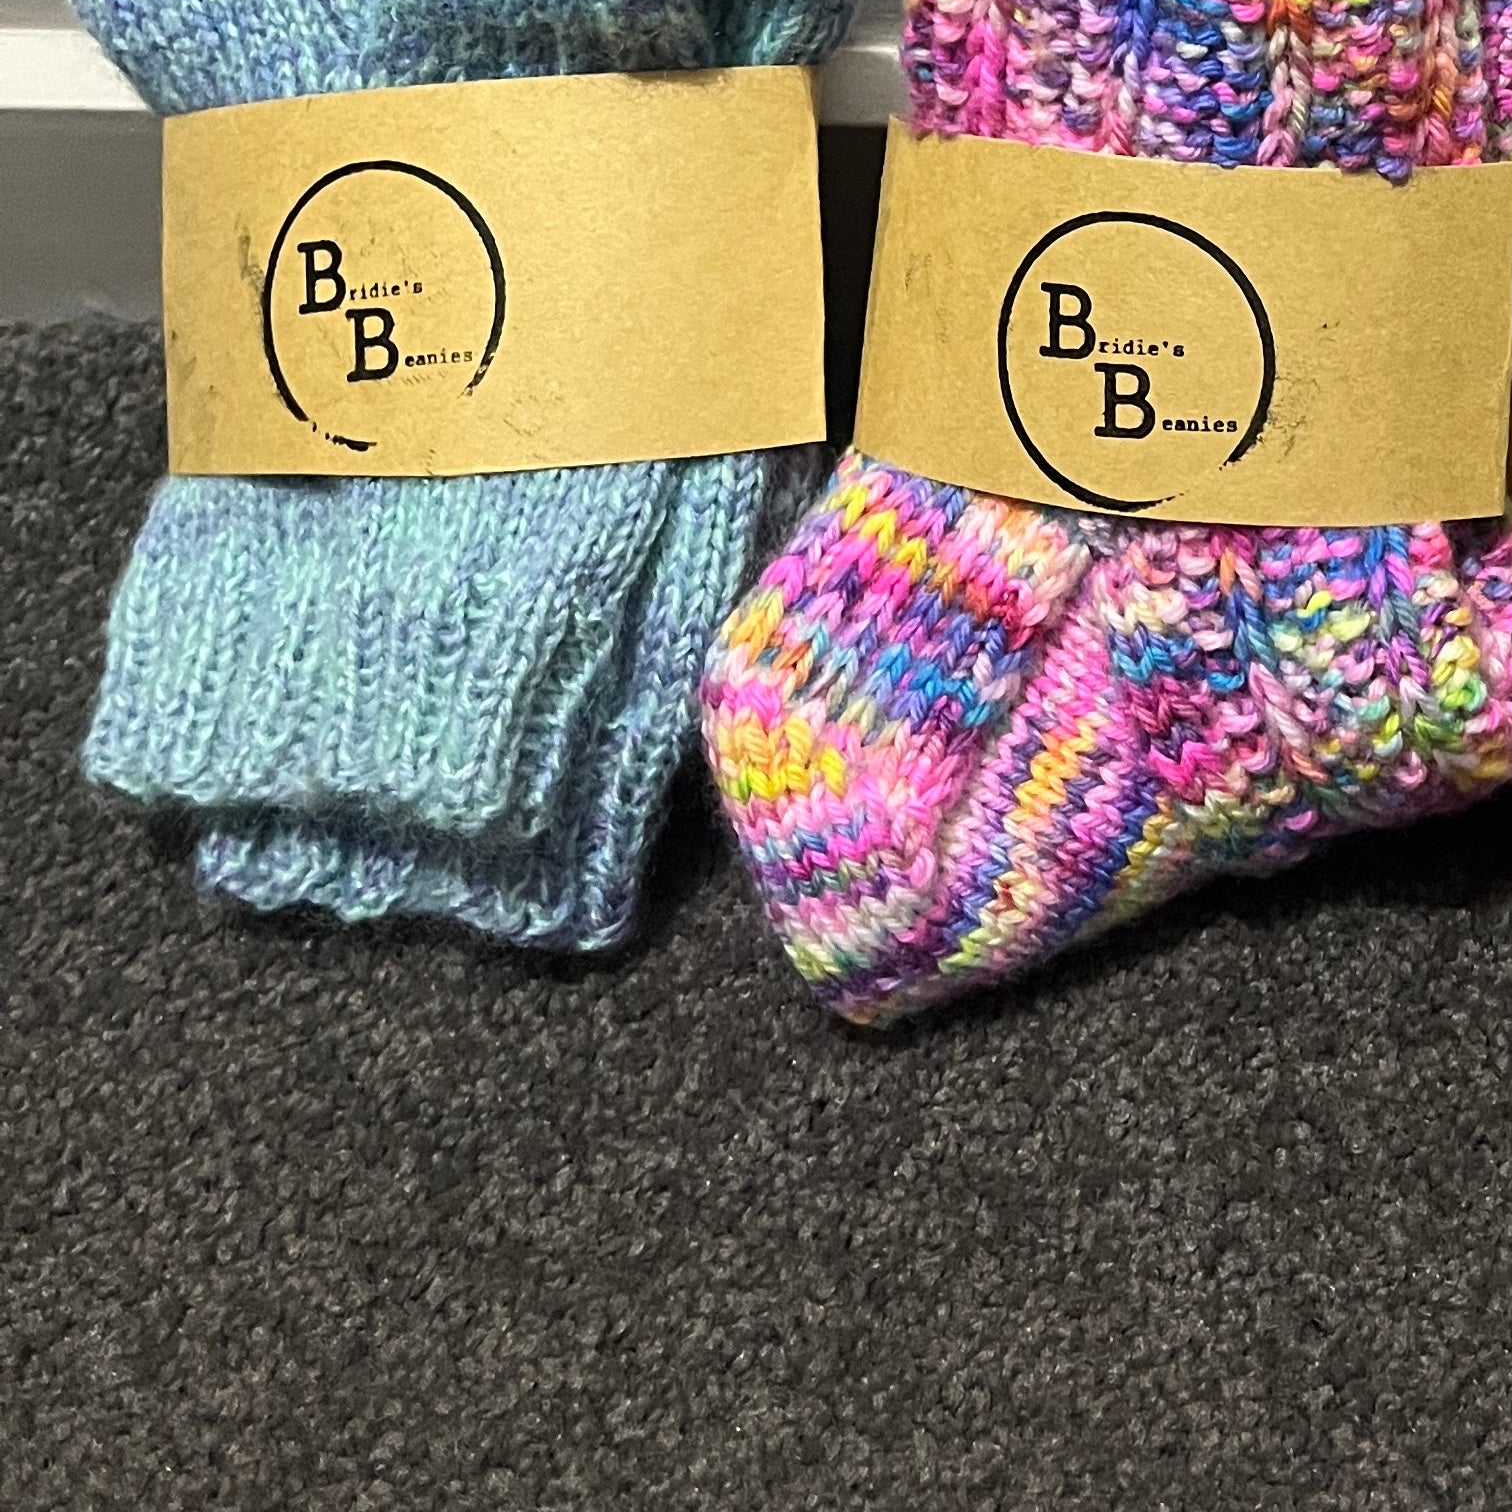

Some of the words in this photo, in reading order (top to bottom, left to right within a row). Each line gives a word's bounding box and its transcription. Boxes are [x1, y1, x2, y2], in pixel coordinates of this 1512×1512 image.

[297, 240, 423, 314] Bridie's
[346, 308, 473, 382] Beanies
[1039, 282, 1185, 359] Bridie's
[1094, 363, 1237, 439] Beanies
